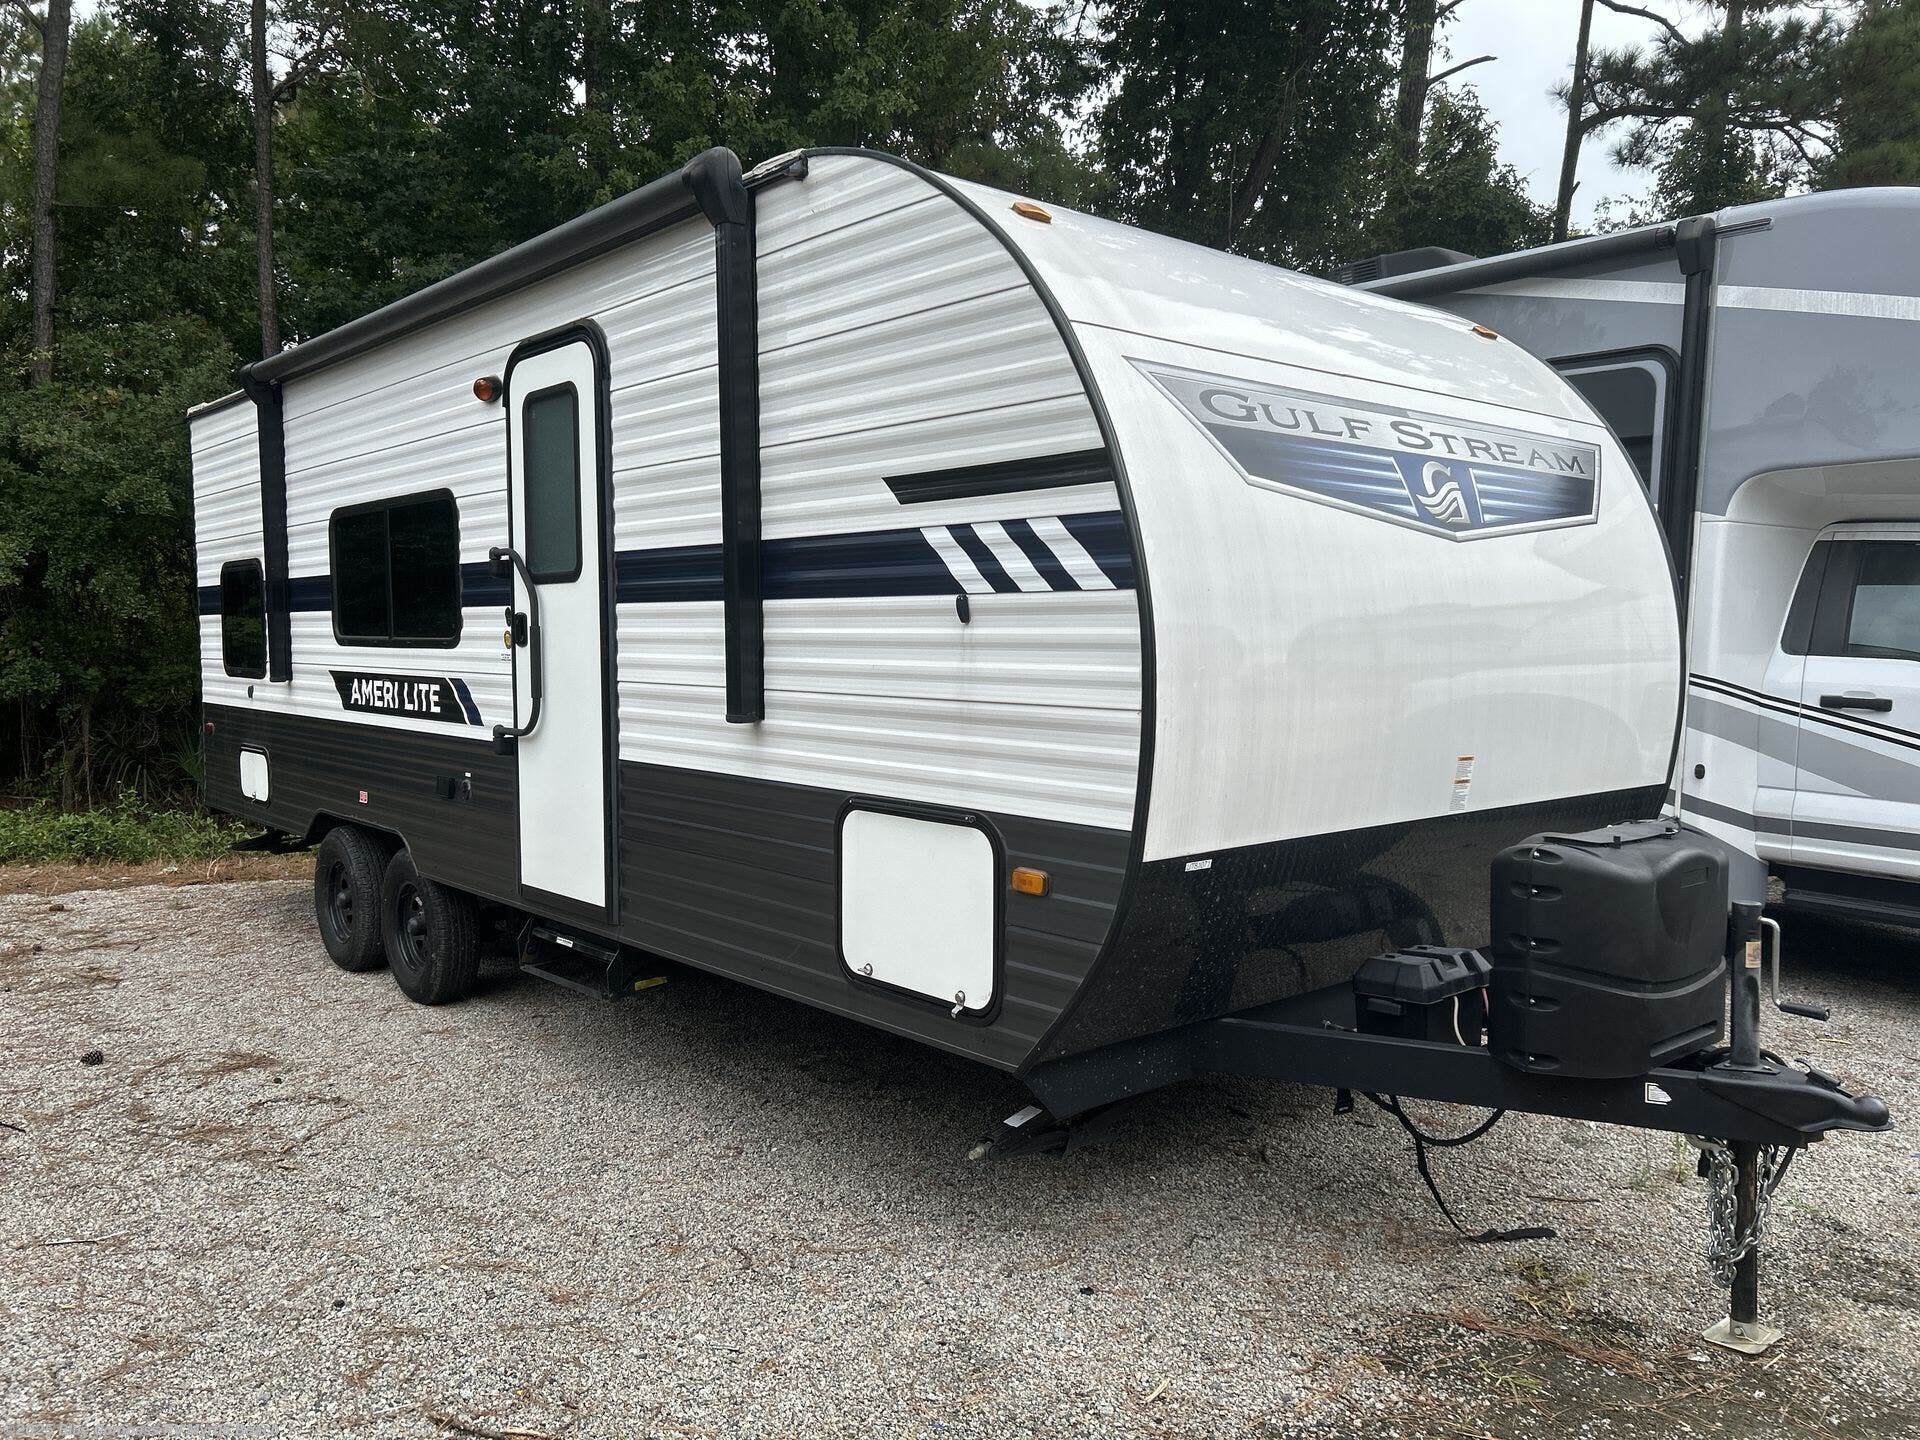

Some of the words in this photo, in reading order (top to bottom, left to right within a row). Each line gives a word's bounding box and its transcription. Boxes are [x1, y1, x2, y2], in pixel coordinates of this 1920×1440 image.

[1199, 388, 1371, 440] GULF
[1390, 421, 1587, 474] STREAM
[350, 678, 399, 709] AMERI
[404, 682, 441, 713] LITE
